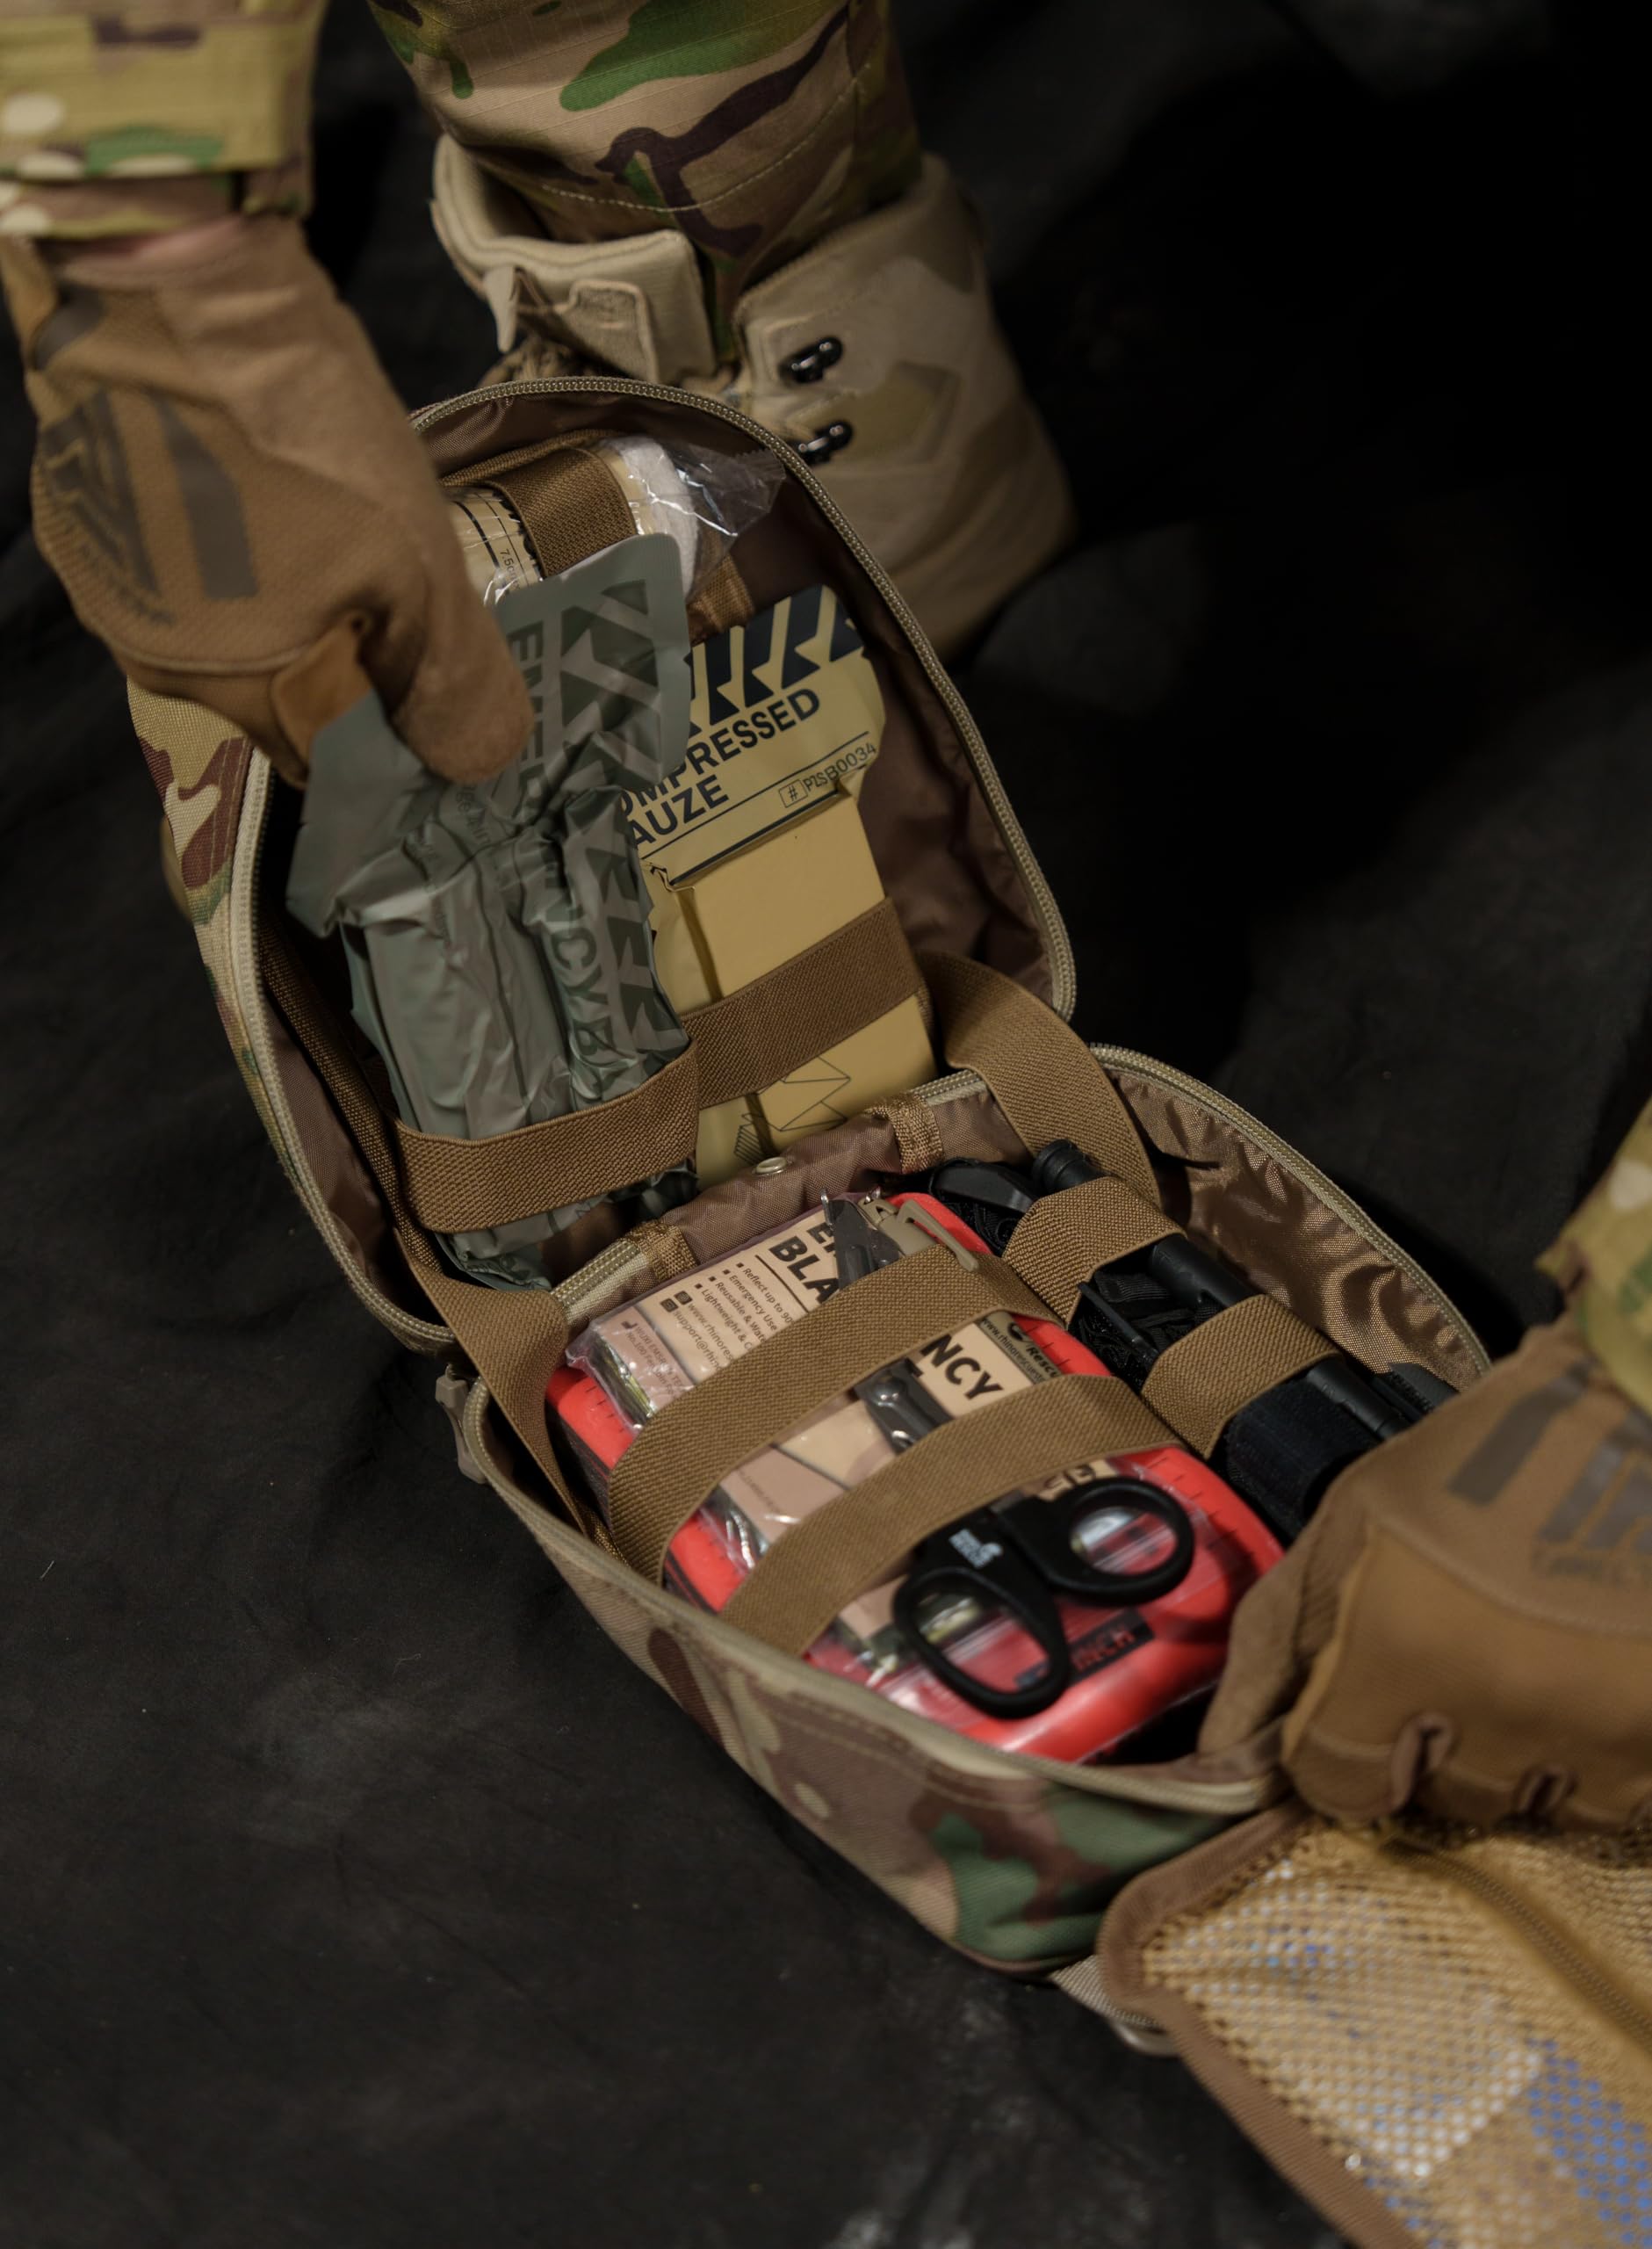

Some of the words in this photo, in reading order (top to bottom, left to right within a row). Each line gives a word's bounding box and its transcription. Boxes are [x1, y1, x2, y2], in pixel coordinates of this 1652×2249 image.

[621, 689, 819, 817] OMPRESSED
[628, 775, 729, 850] AUZE
[714, 1281, 746, 1316] Reusable
[728, 1275, 767, 1314] Emergency
[761, 1313, 778, 1332] Use
[743, 1268, 768, 1293] Reflect
[701, 1289, 741, 1334] Lightweight
